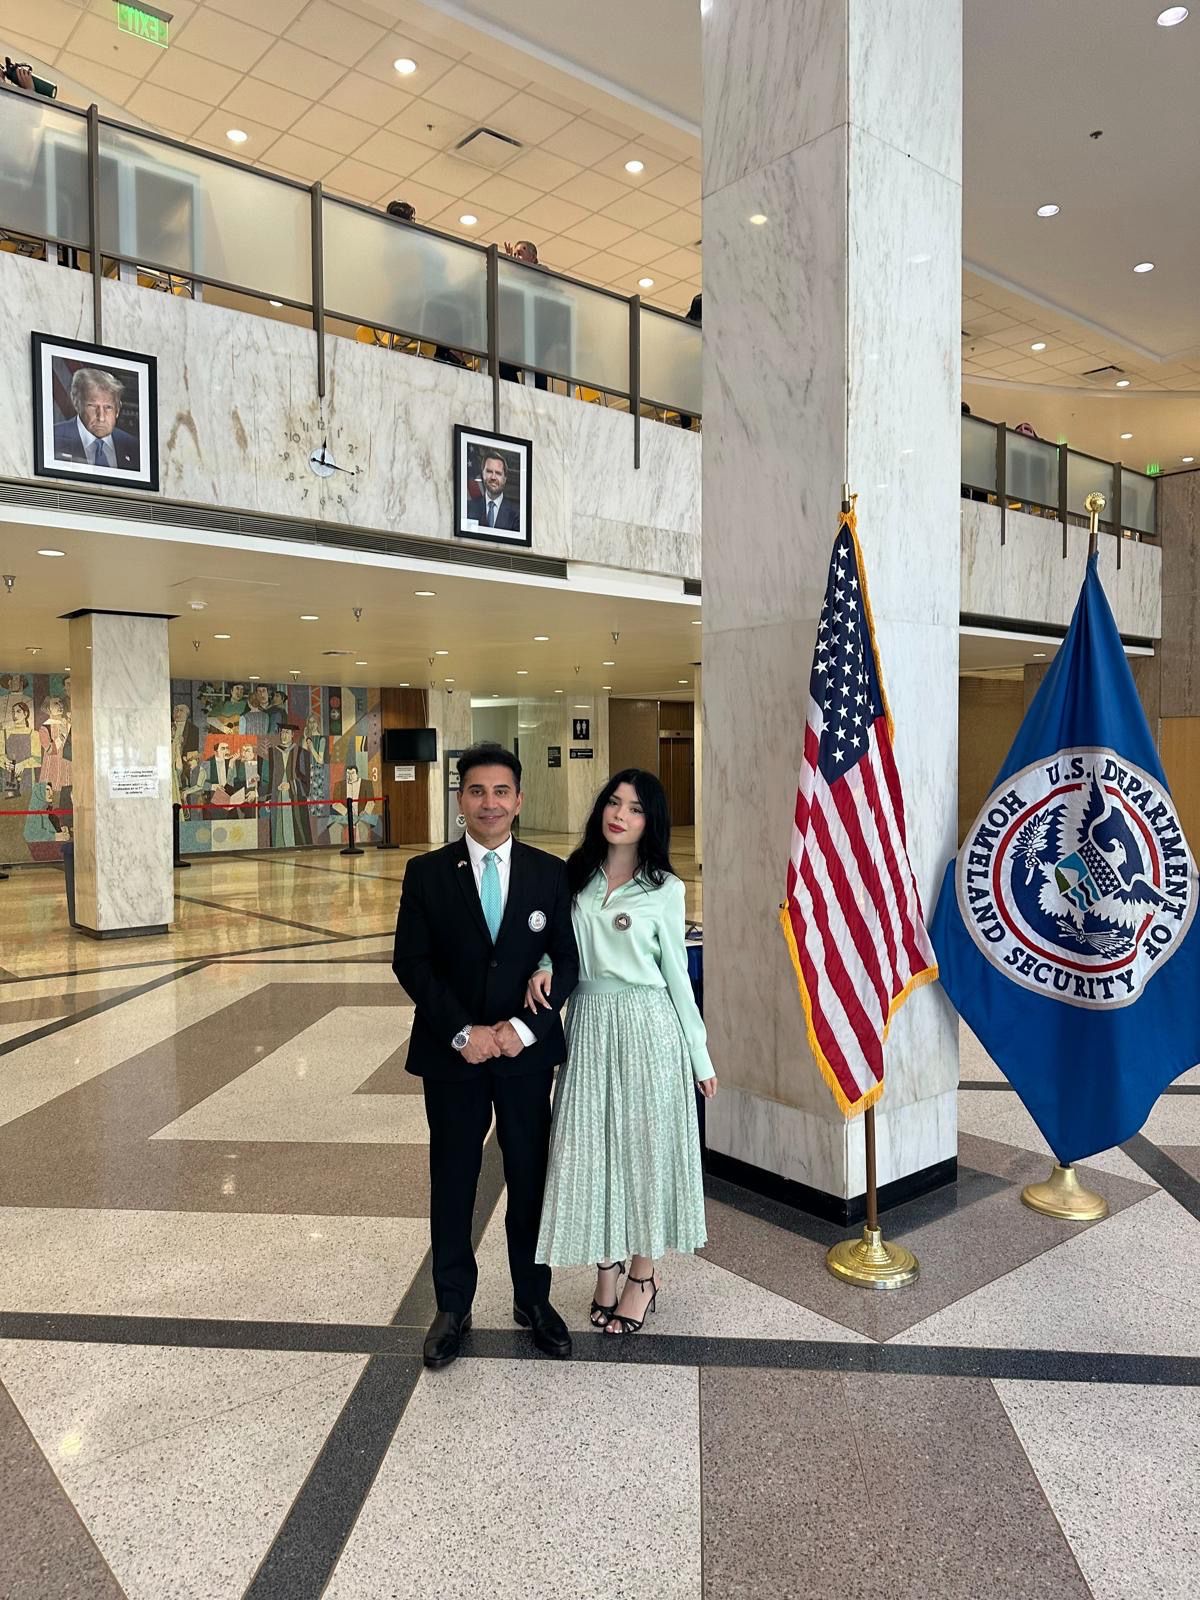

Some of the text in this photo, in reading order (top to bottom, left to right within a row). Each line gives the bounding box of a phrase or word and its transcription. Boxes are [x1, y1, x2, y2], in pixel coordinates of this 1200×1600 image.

[303, 422, 309, 433] 11
[318, 419, 325, 431] 12
[289, 432, 301, 443] 10
[348, 443, 354, 454] 2
[283, 451, 290, 461] 9
[355, 465, 361, 475] 3
[289, 472, 295, 481] 8
[303, 488, 309, 498] 7
[336, 494, 343, 504] 5
[372, 767, 378, 782] 3
[1046, 757, 1188, 961] U.S. DEPARTMENT OF
[966, 789, 1136, 1000] HOMELAND SECURITY
